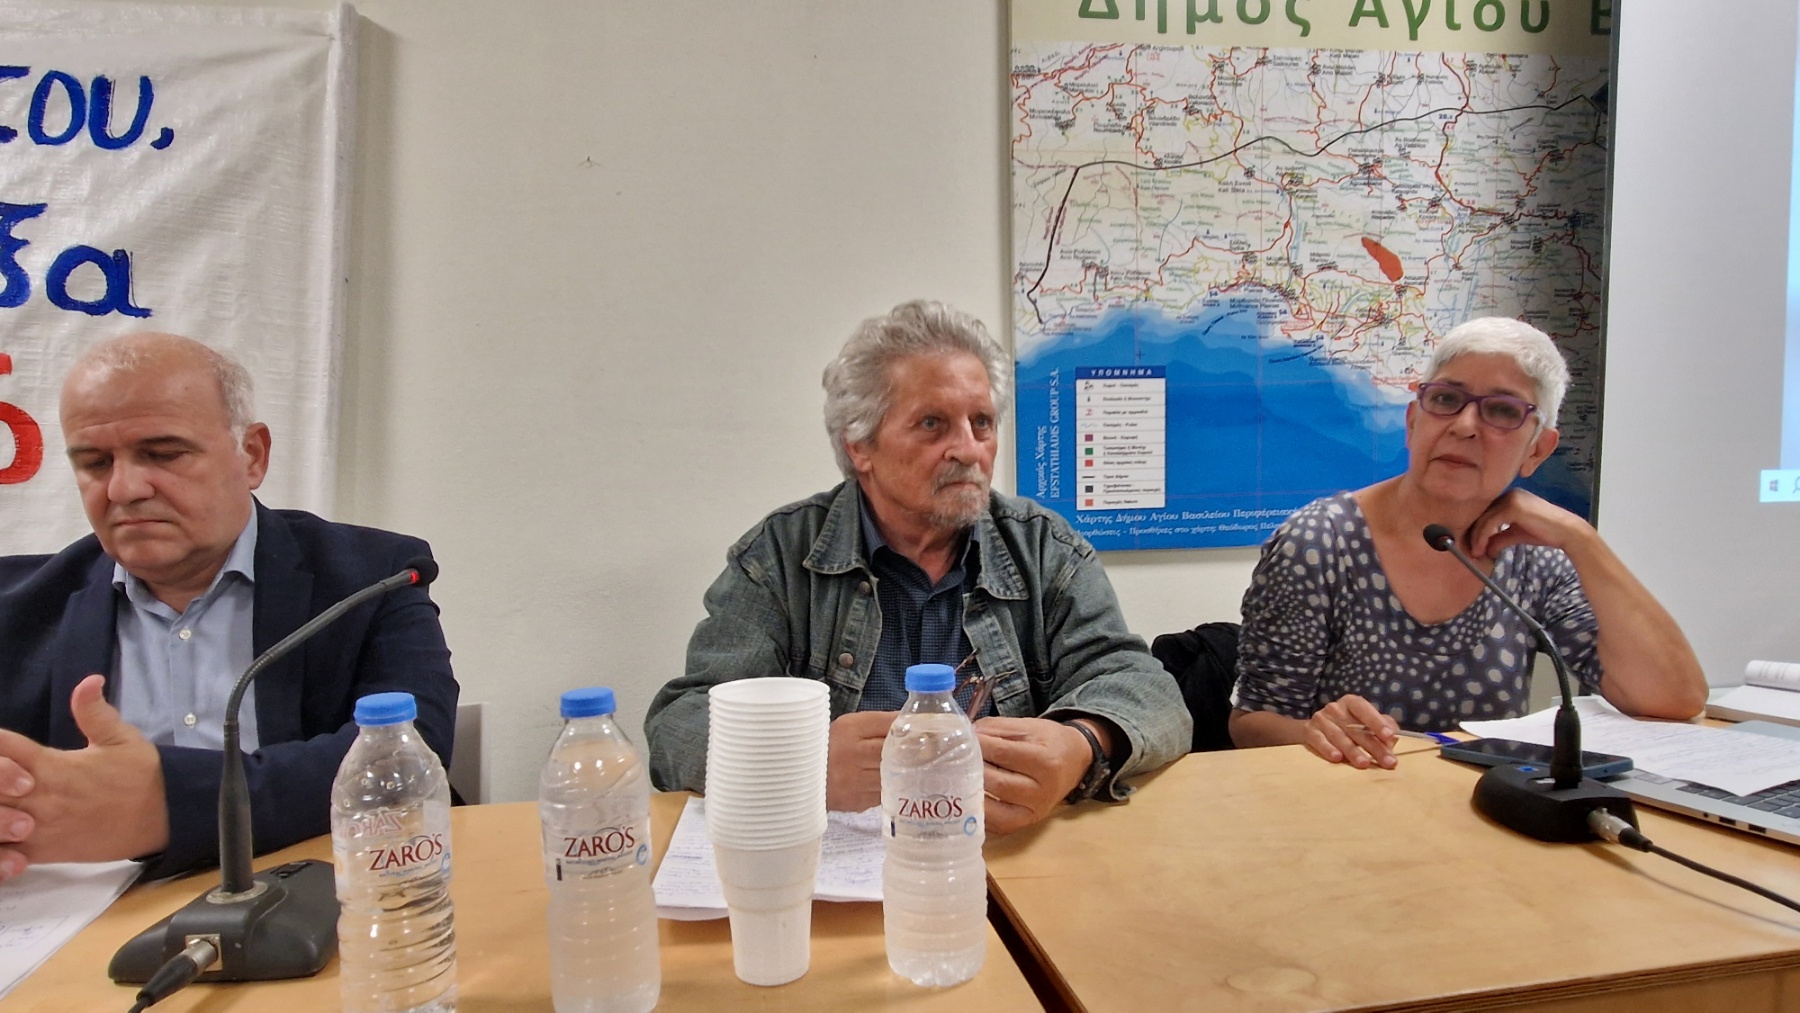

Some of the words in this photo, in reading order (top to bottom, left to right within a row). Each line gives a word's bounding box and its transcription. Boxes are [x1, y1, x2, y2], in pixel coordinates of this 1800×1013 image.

[1049, 386, 1060, 423] GROUP
[1049, 424, 1060, 499] EFSTATHIADIS
[1115, 512, 1148, 524] Δήμου
[1149, 510, 1180, 523] Αγίου
